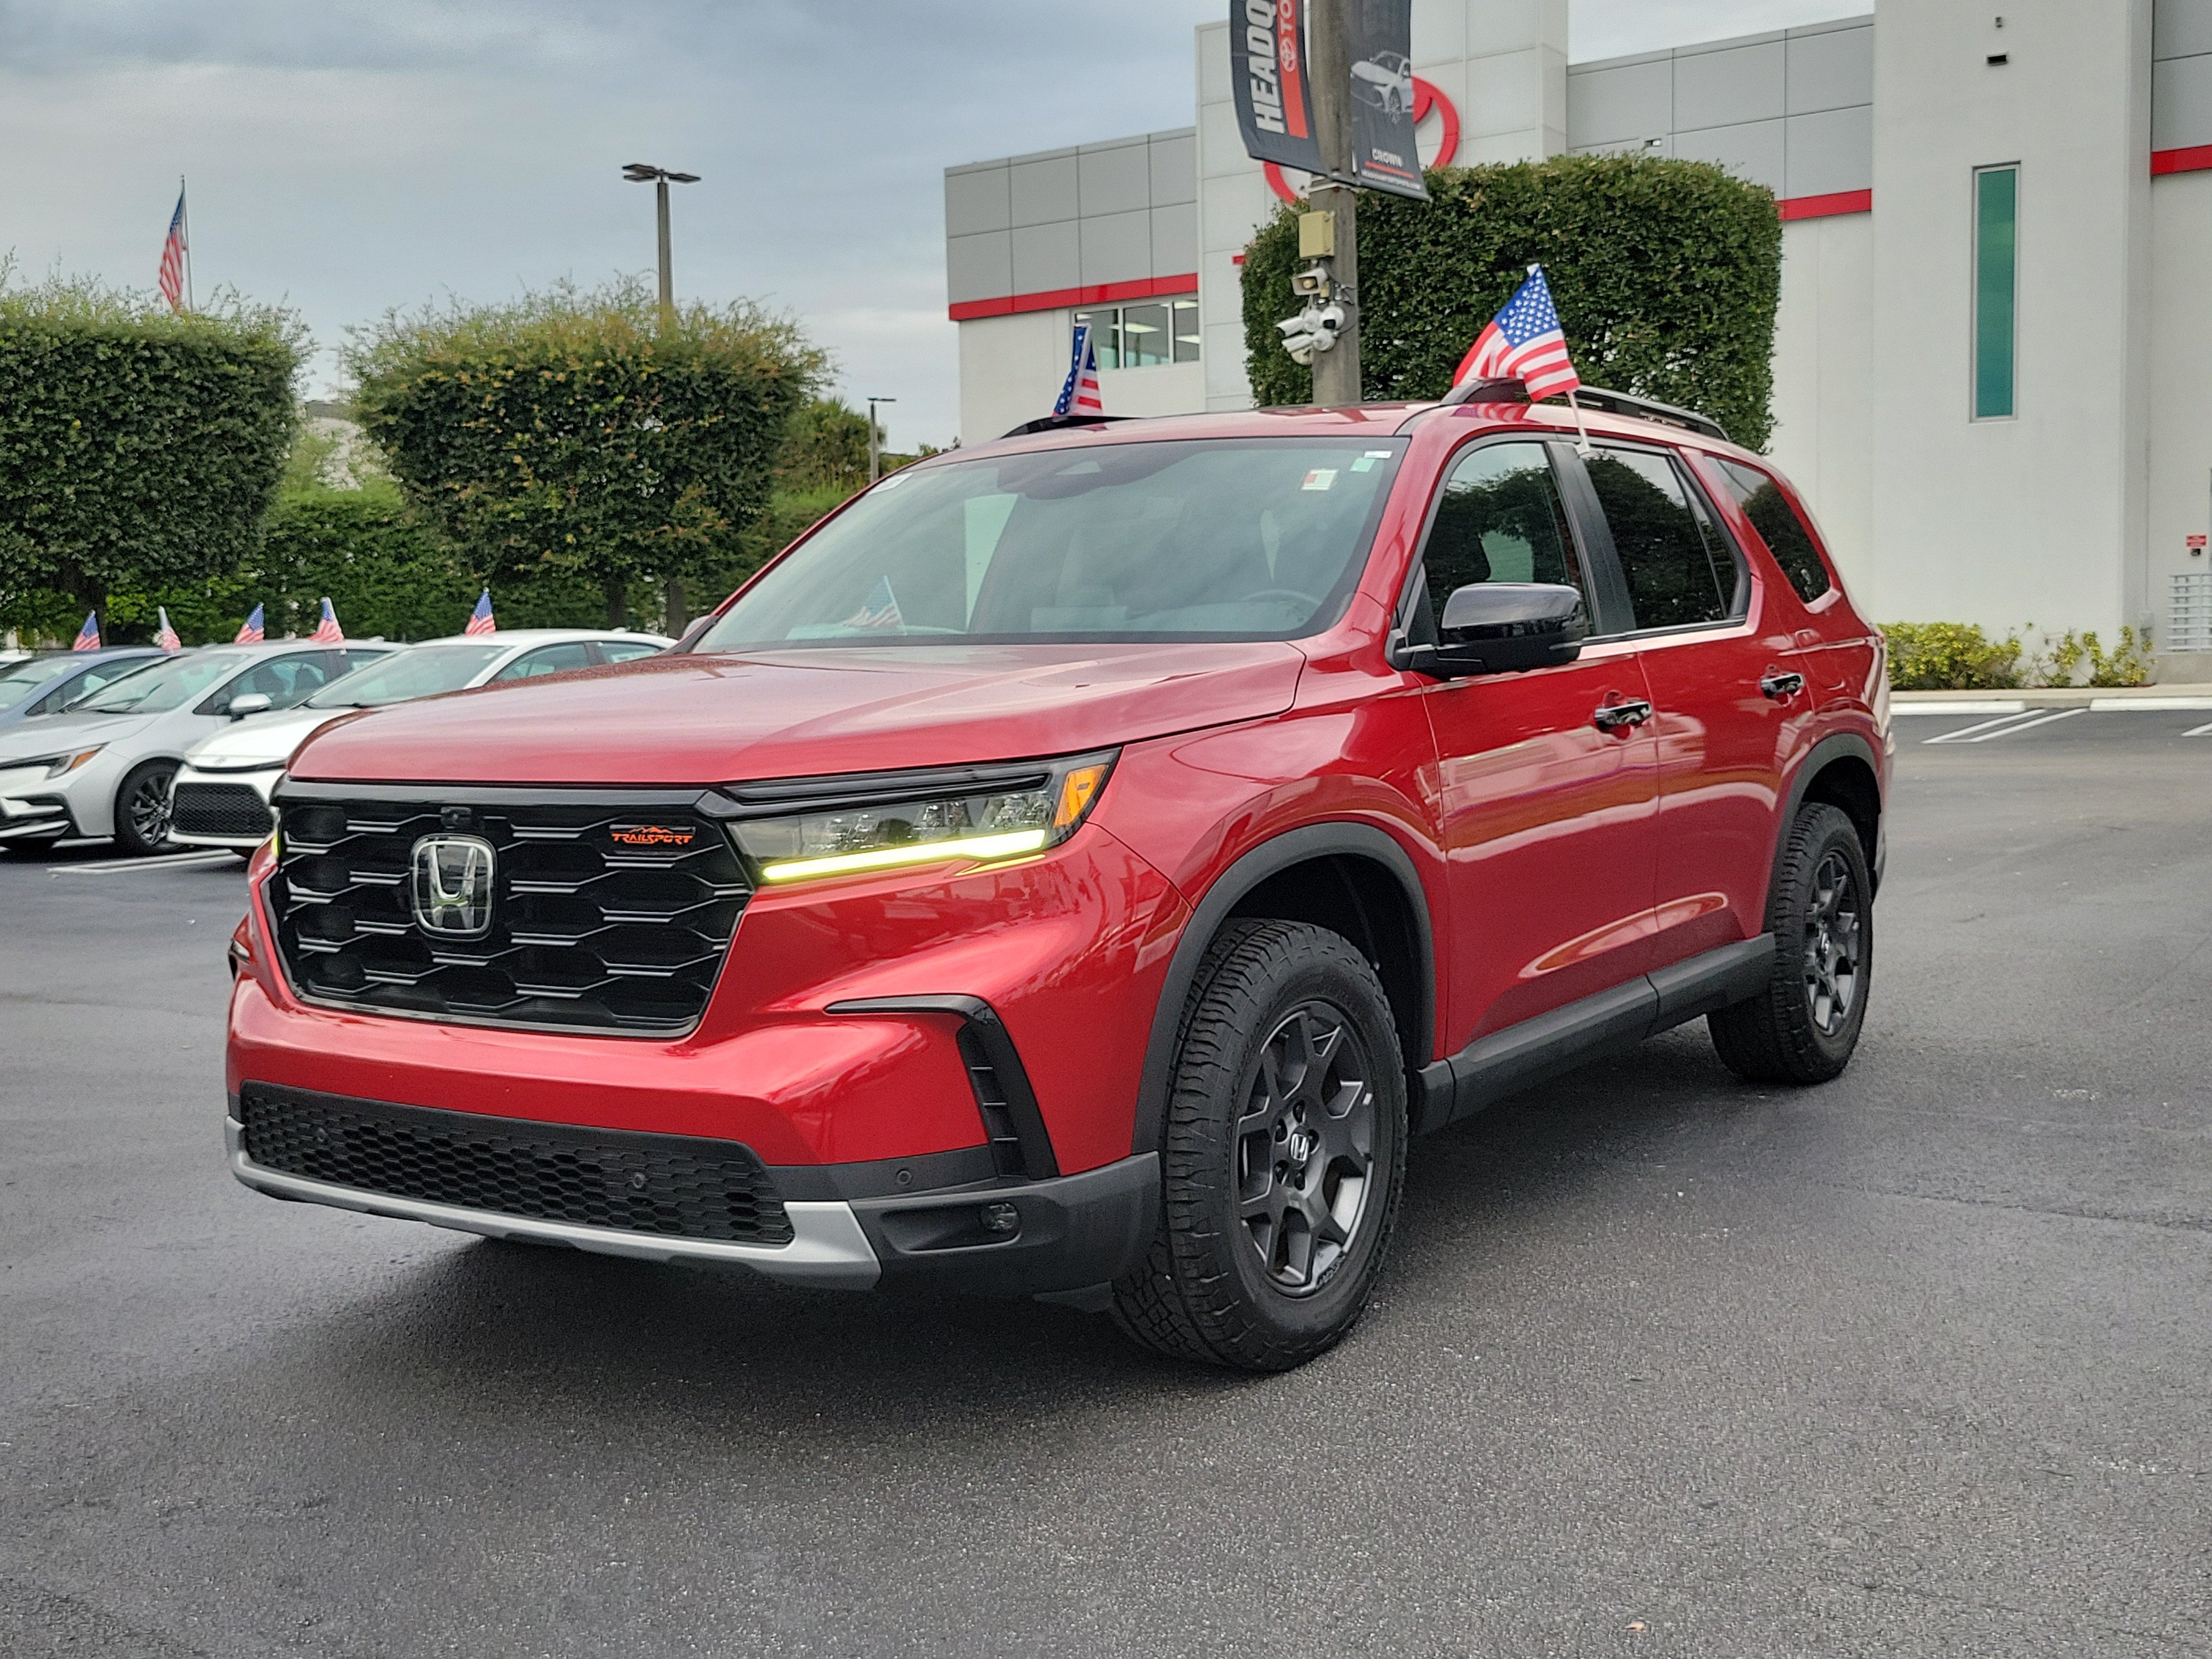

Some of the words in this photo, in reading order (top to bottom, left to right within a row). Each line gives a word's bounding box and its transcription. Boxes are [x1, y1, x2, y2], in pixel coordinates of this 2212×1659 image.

[1245, 0, 1285, 134] HEADQ
[1372, 148, 1403, 168] CROWN
[611, 833, 693, 845] TRAILSPORT
